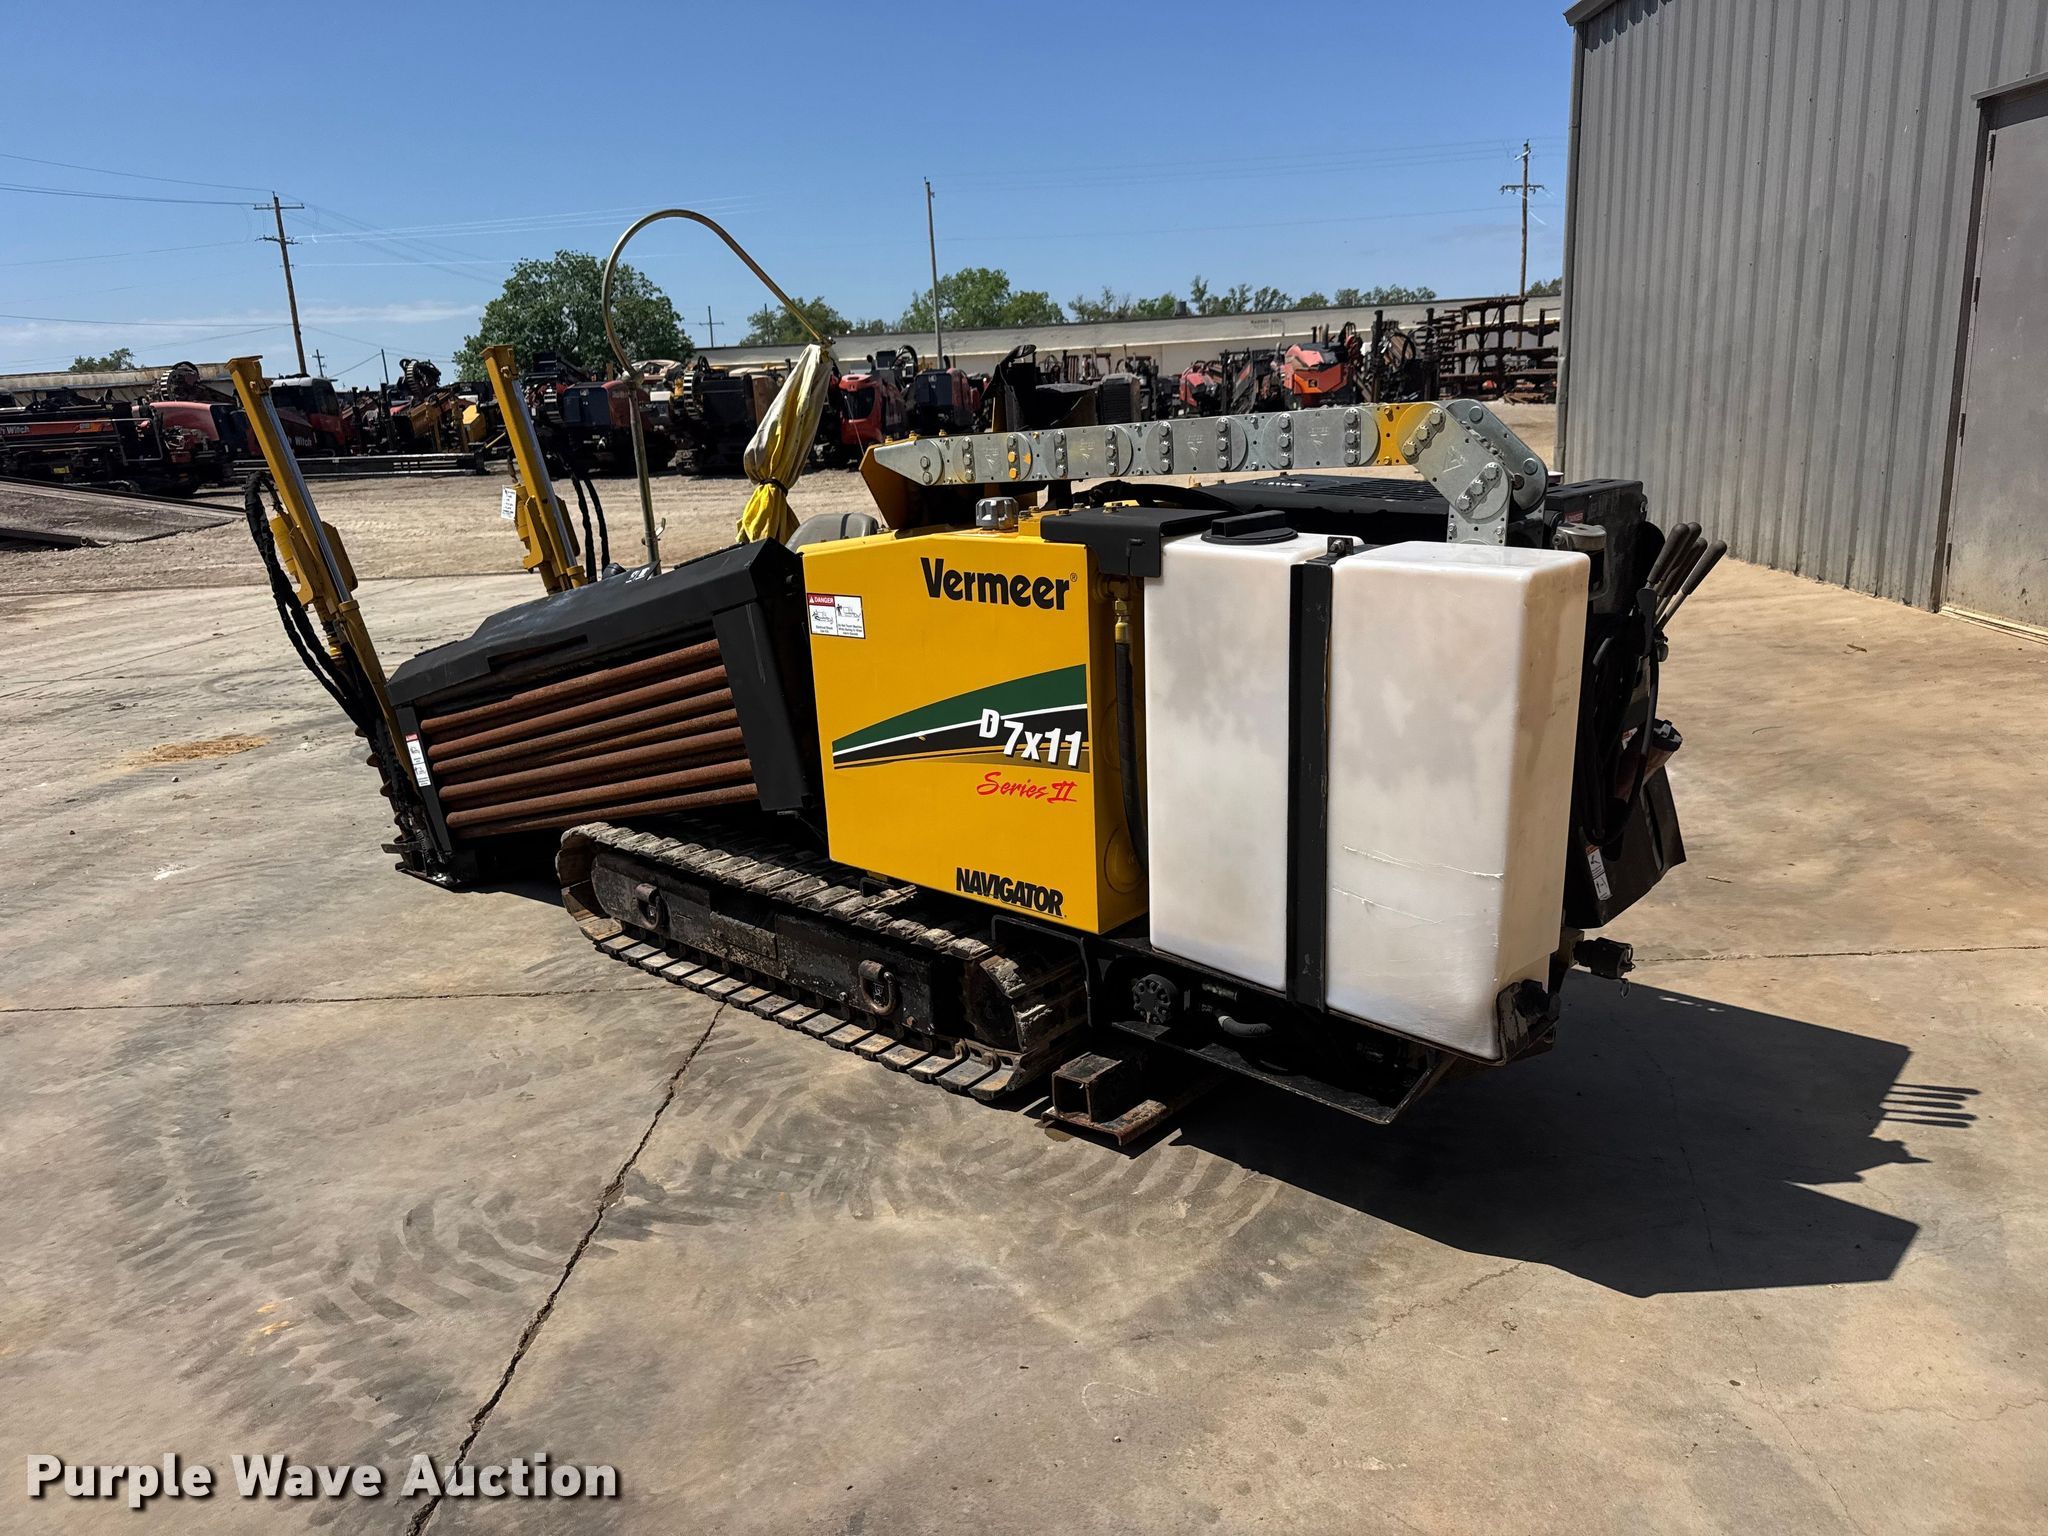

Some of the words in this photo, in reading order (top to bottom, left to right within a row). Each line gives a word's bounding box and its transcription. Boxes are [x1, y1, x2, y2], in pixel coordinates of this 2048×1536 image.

[814, 596, 833, 604] DANGER
[976, 771, 1048, 799] Series
[956, 866, 1064, 917] NAVIGATOR
